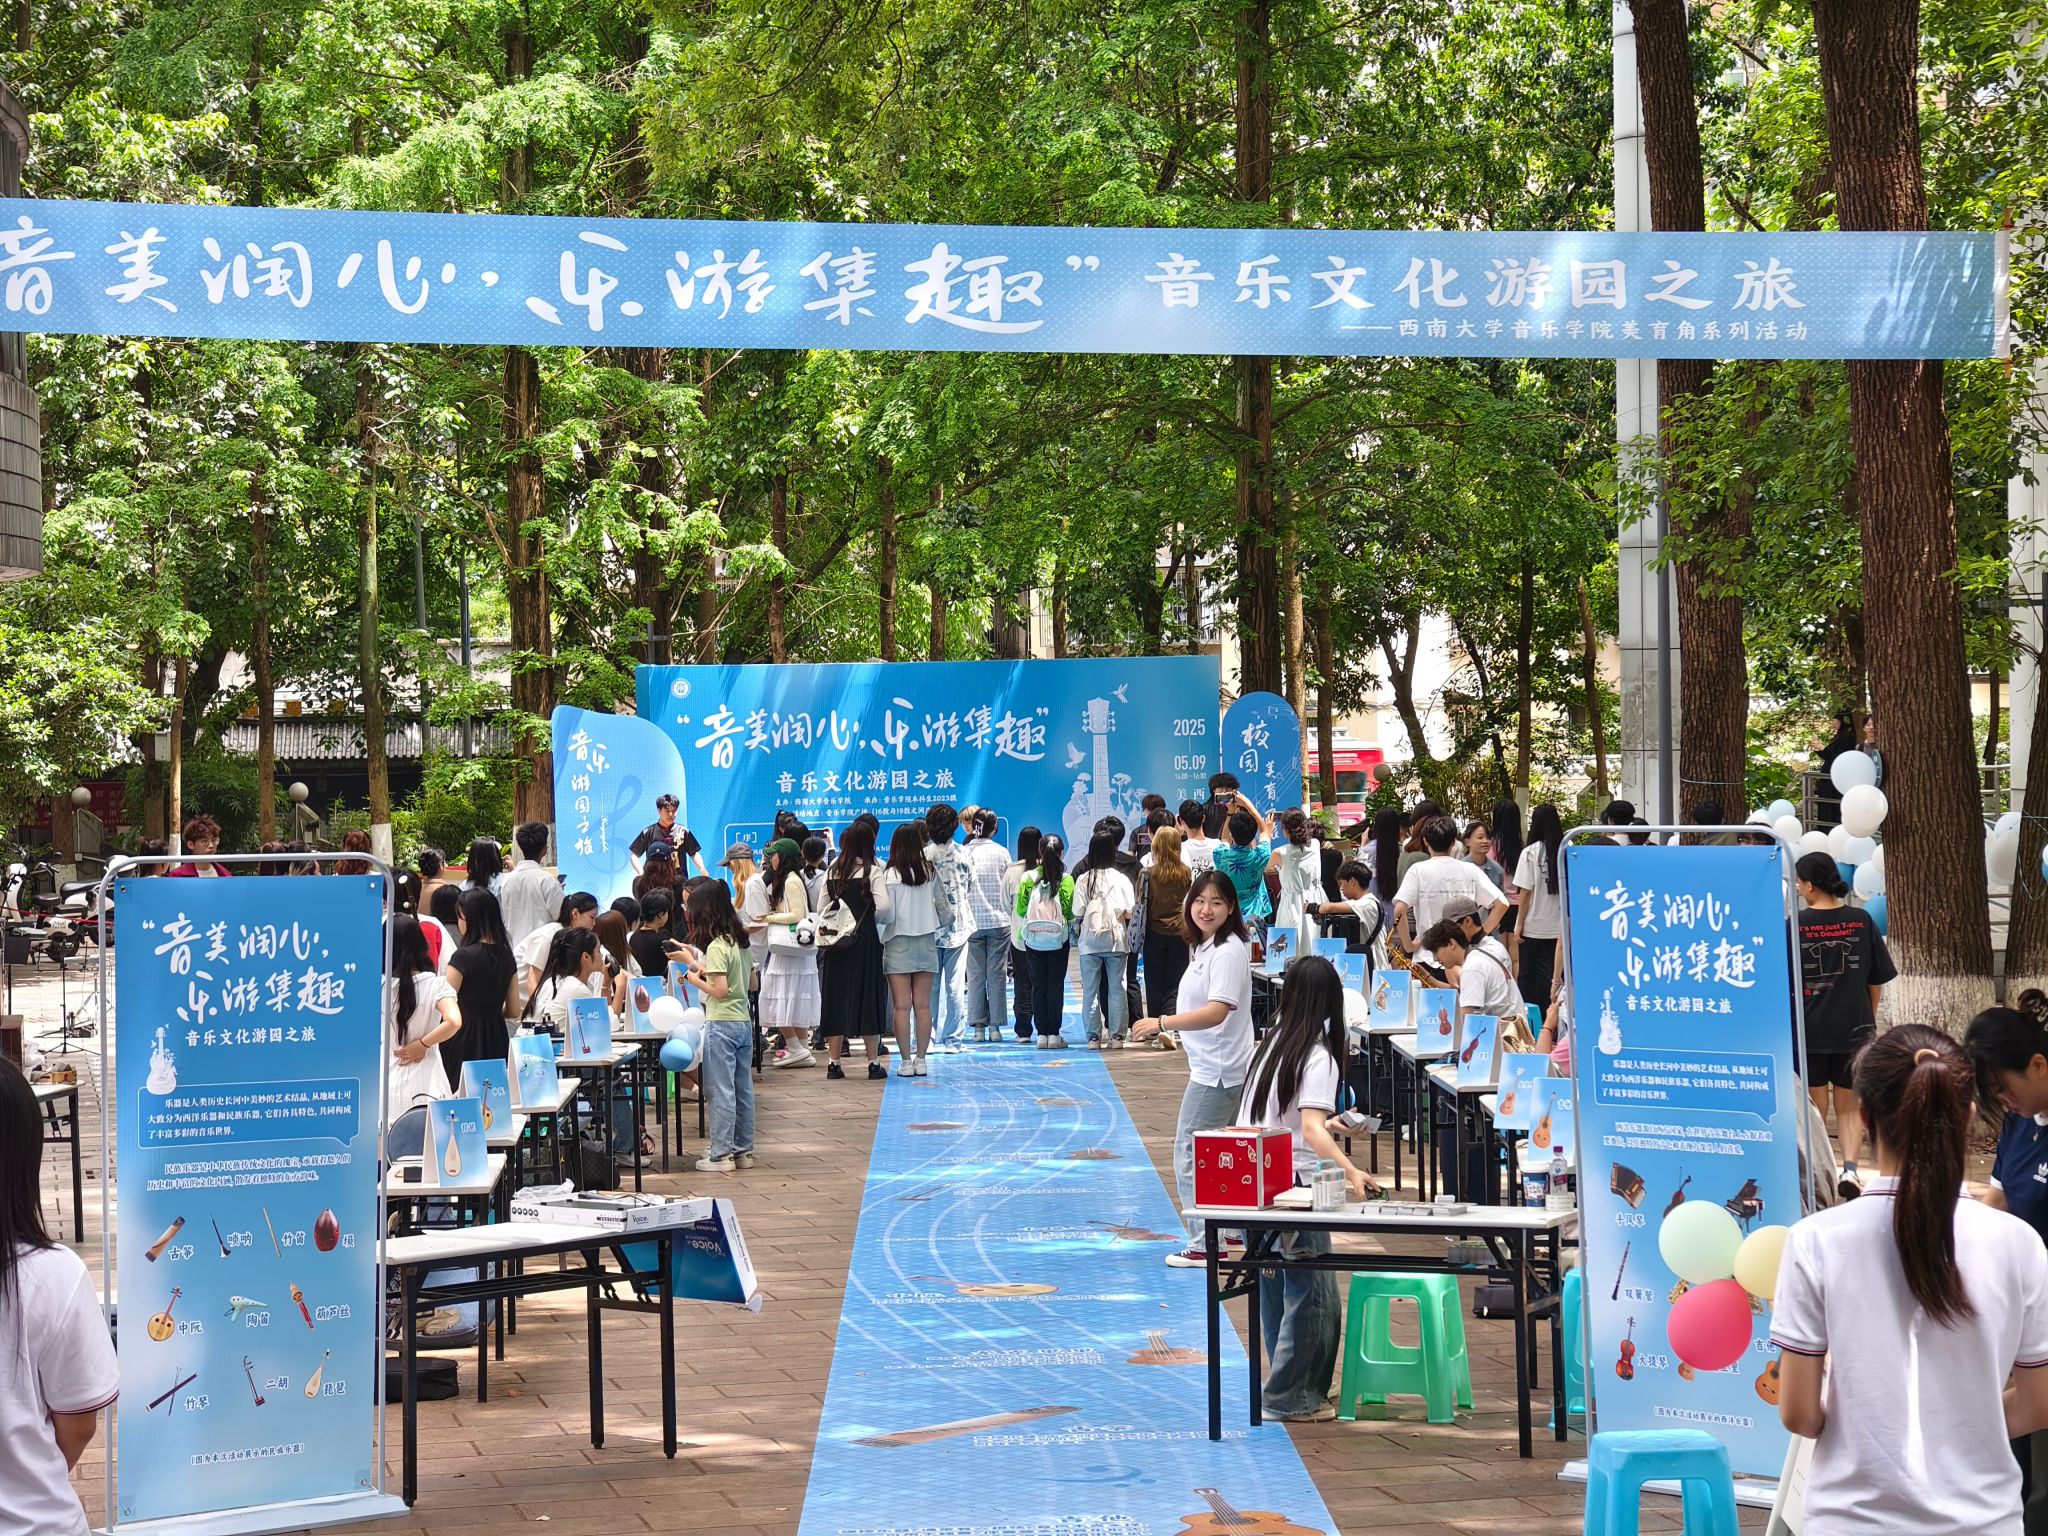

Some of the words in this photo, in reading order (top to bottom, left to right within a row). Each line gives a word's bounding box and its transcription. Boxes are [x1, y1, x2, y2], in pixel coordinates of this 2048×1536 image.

[1144, 253, 1806, 311] 音乐文化游园之旅
[1174, 719, 1205, 736] 2025
[1240, 720, 1270, 773] 校园
[1175, 755, 1206, 770] 05.09
[776, 768, 956, 793] 音乐文化游园之旅
[1625, 994, 1733, 1014] 音乐文化游园之旅
[185, 1027, 316, 1047] 音乐文化游园之旅
[1615, 1213, 1645, 1227] 手风琴
[227, 1232, 252, 1247] 唢呐
[282, 1231, 306, 1246] 竹笛
[342, 1234, 355, 1248] 埙
[168, 1245, 194, 1261] 古筝
[1624, 1288, 1654, 1302] 双簧管
[246, 1312, 270, 1327] 陶笛
[315, 1304, 351, 1320] 葫芦丝
[178, 1320, 203, 1335] 中阮
[1638, 1354, 1669, 1369] 大提琴
[265, 1376, 289, 1390] 二胡
[323, 1381, 346, 1395] 琵琶
[184, 1396, 210, 1411] 竹琴
